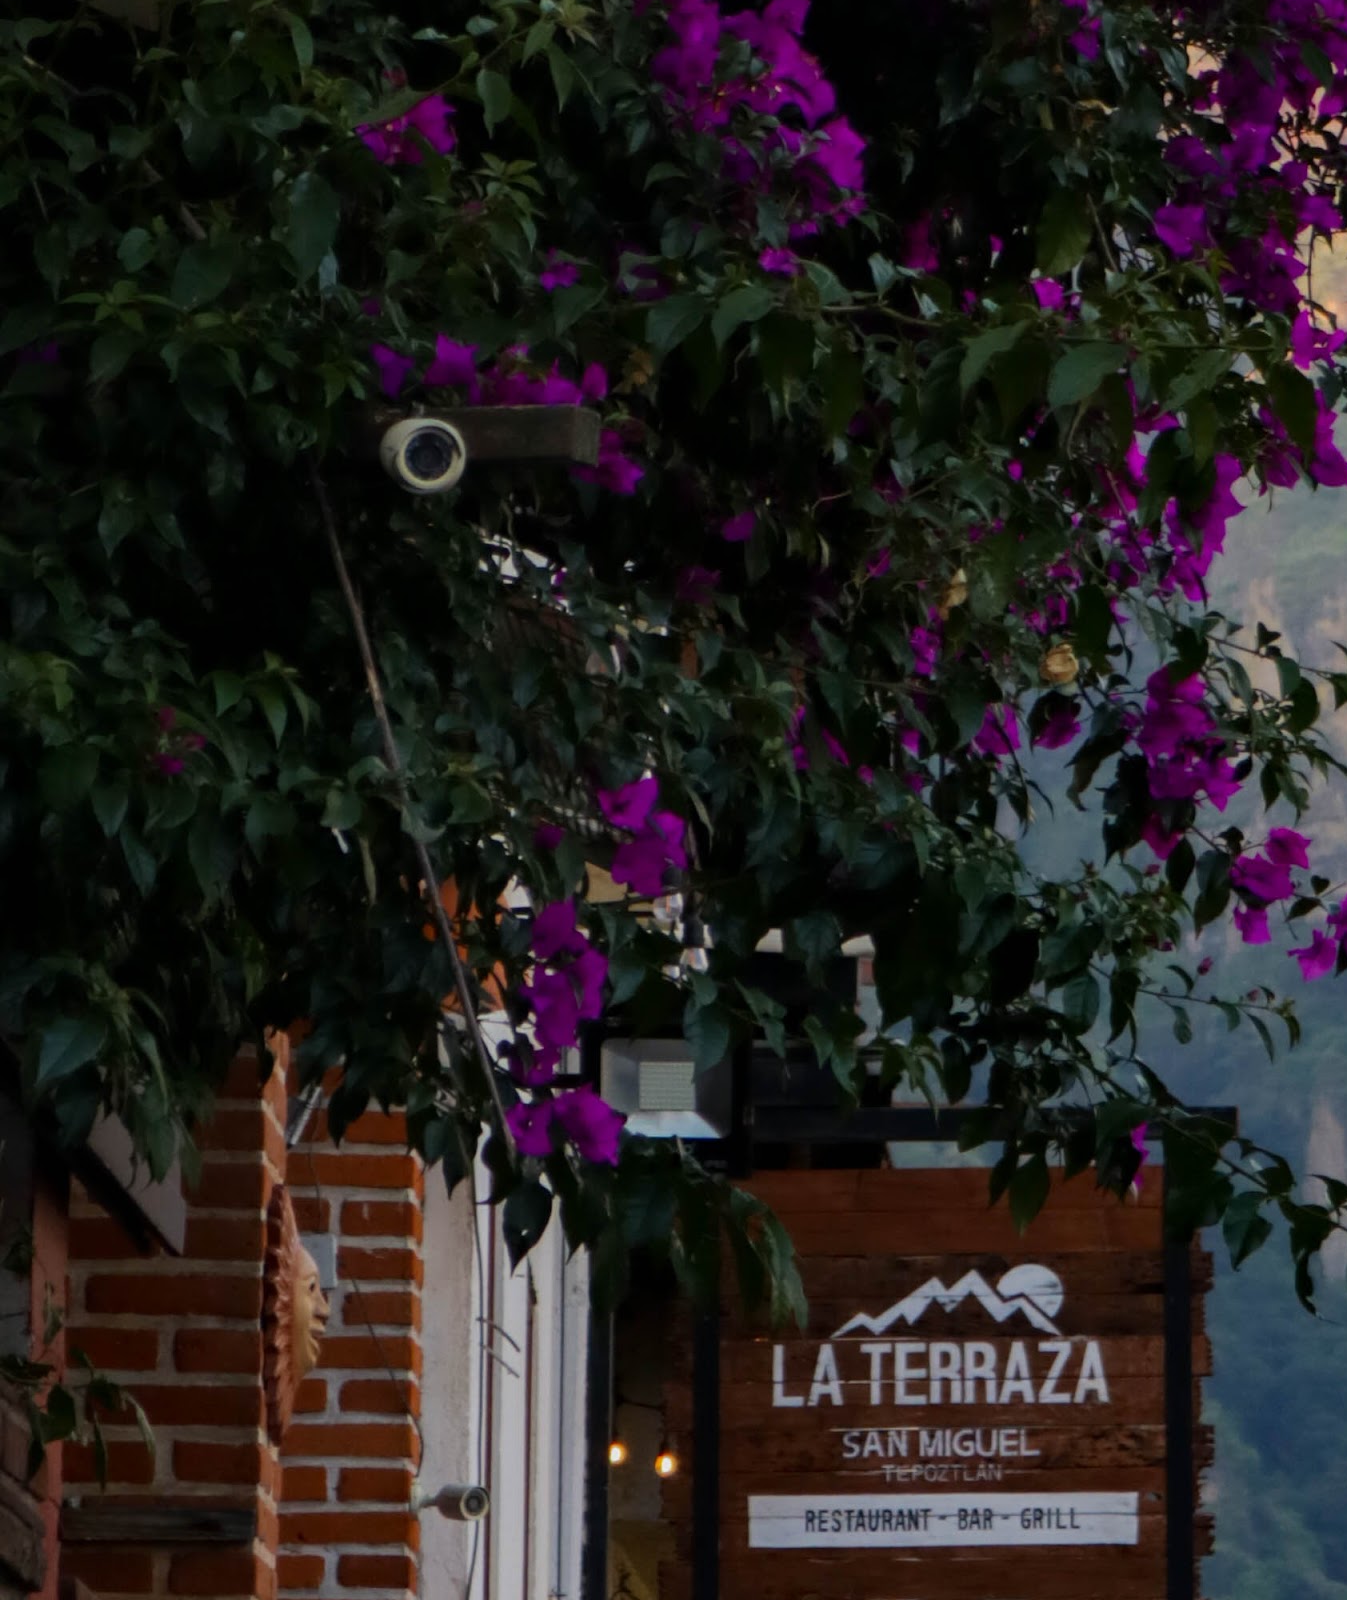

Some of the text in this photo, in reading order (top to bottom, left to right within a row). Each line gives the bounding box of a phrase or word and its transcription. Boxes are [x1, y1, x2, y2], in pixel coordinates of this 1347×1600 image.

[772, 1340, 1111, 1407] LA TERRAZA
[842, 1427, 1041, 1459] SAN MIGUEL
[804, 1508, 932, 1533] RESTAURANT
[957, 1508, 994, 1531] BAR
[1020, 1506, 1081, 1530] GRILL
